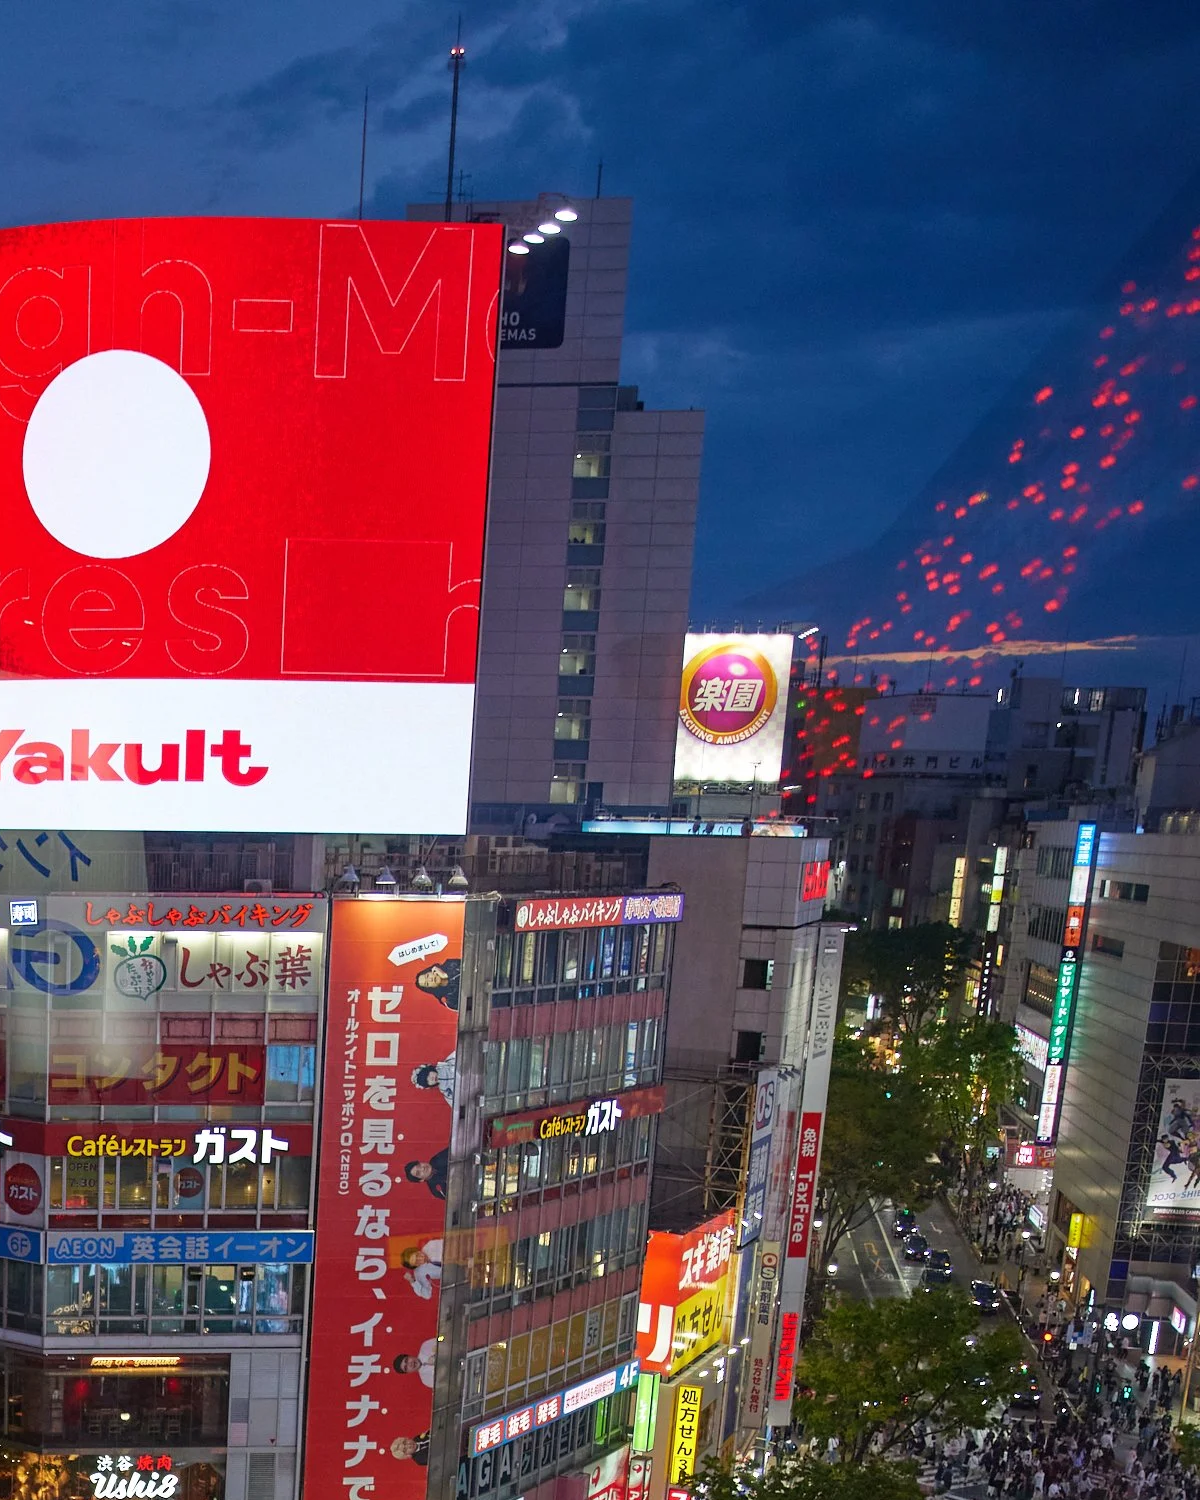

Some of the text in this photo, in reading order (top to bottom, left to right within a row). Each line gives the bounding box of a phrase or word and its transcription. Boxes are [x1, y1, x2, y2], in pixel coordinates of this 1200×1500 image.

[693, 677, 765, 714] 楽園
[678, 707, 772, 746] EXCITING AMUSEMENT
[84, 900, 315, 928] しゃぶしゃぶバイキング
[528, 899, 623, 928] しゃぶしゃぶバイキング
[179, 943, 312, 990] しゃぶ葉
[51, 1051, 259, 1094] コンタクト
[585, 1099, 622, 1137] ガスト
[66, 1128, 289, 1165] Caféレストラン ガスト
[9, 1183, 38, 1200] ガスト
[791, 1127, 817, 1244] 免税 TaxFree
[8, 1235, 29, 1254] 6F
[55, 1234, 309, 1263] AEON 英会話イーオン
[678, 1225, 733, 1291] スギ薬局
[761, 1252, 778, 1281] OS
[586, 1326, 599, 1347] 5F
[477, 1422, 502, 1451] 薄毛
[507, 1409, 531, 1438] 抜毛
[536, 1397, 558, 1425] 発毛
[619, 1360, 639, 1388] 4F
[676, 1388, 699, 1457] 処方せん
[96, 1454, 173, 1472] 渋谷 焼肉
[89, 1471, 179, 1500] Ushi8
